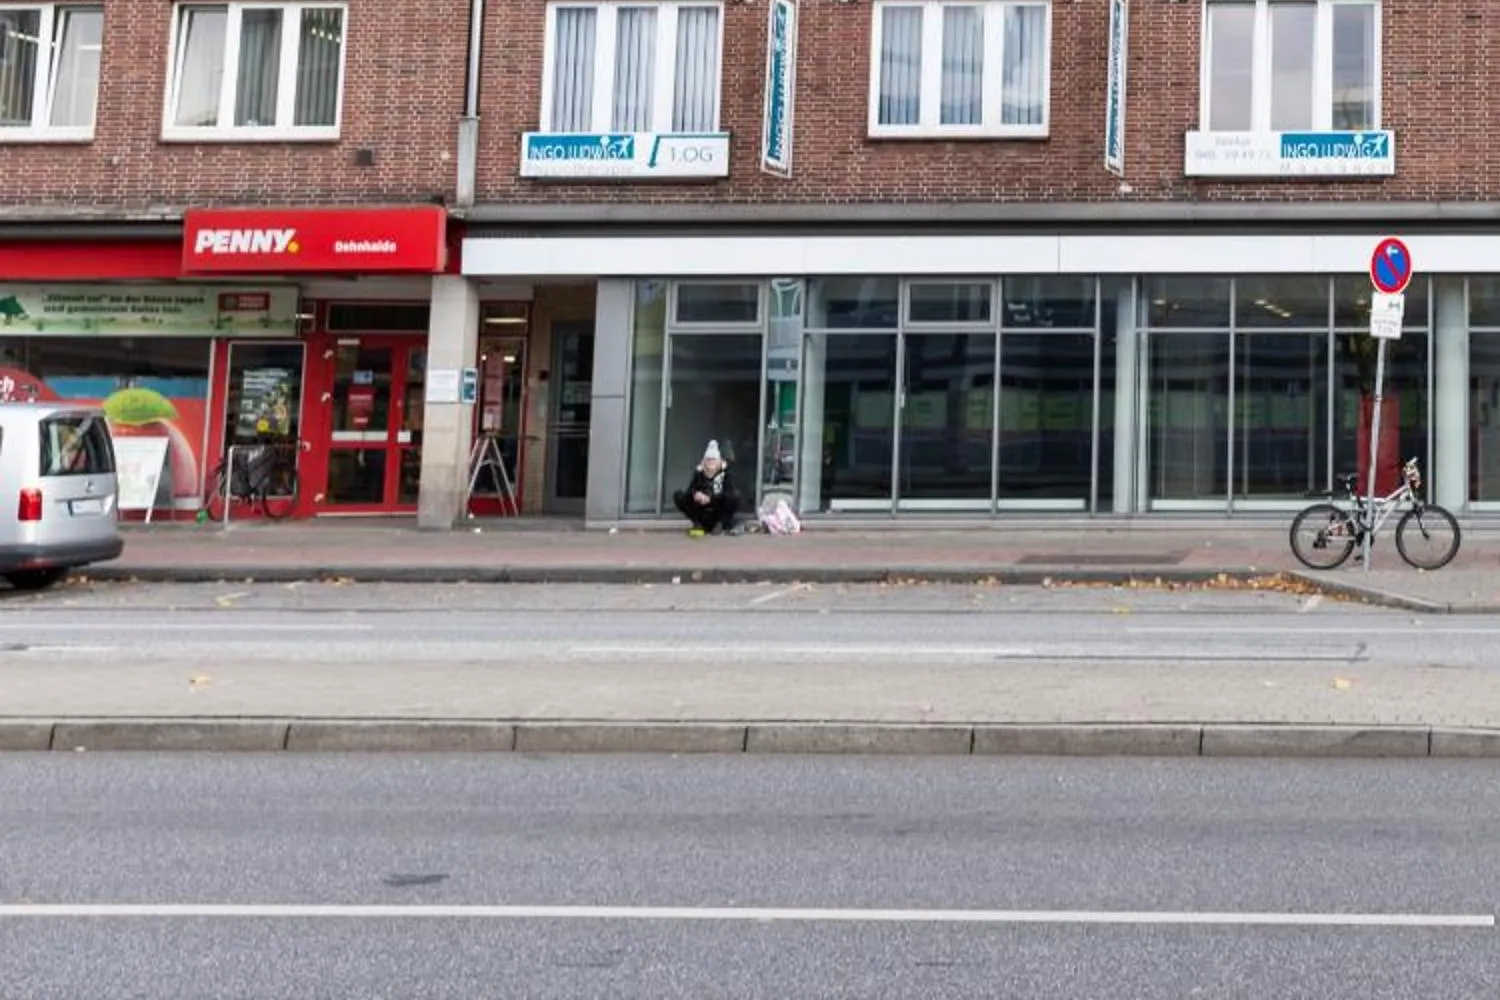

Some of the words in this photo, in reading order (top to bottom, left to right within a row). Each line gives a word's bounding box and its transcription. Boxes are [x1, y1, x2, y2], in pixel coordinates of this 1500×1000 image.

[529, 144, 565, 160] INGO
[567, 144, 618, 160] LUDWIG
[1282, 143, 1319, 158] INGO
[1321, 143, 1373, 158] LUDWIG
